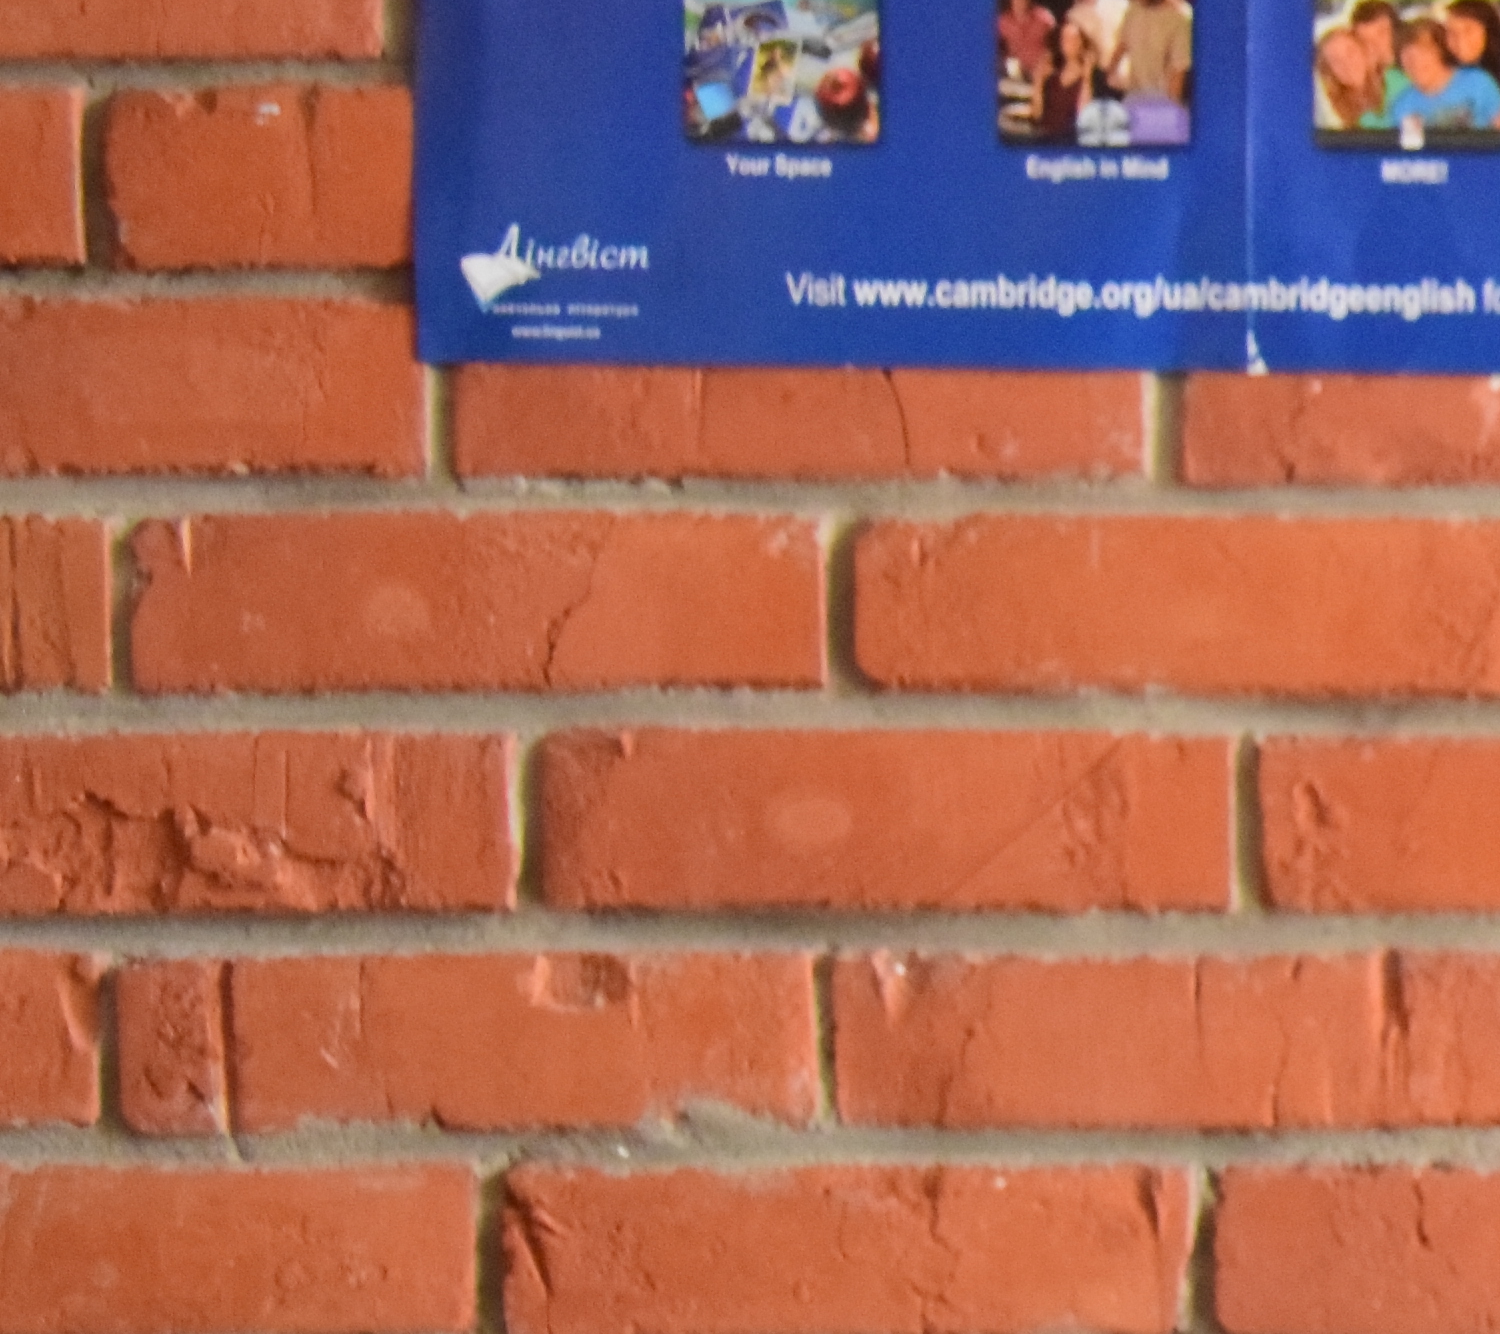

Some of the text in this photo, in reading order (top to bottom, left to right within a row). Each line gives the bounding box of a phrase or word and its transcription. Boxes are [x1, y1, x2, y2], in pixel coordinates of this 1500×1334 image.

[726, 154, 832, 182] Your Space
[1026, 155, 1168, 183] English in Mind
[1381, 160, 1449, 185] MORE!
[786, 272, 847, 310] Visit
[853, 272, 1475, 322] www.cambridge.org/ua/cambridgeenglish
